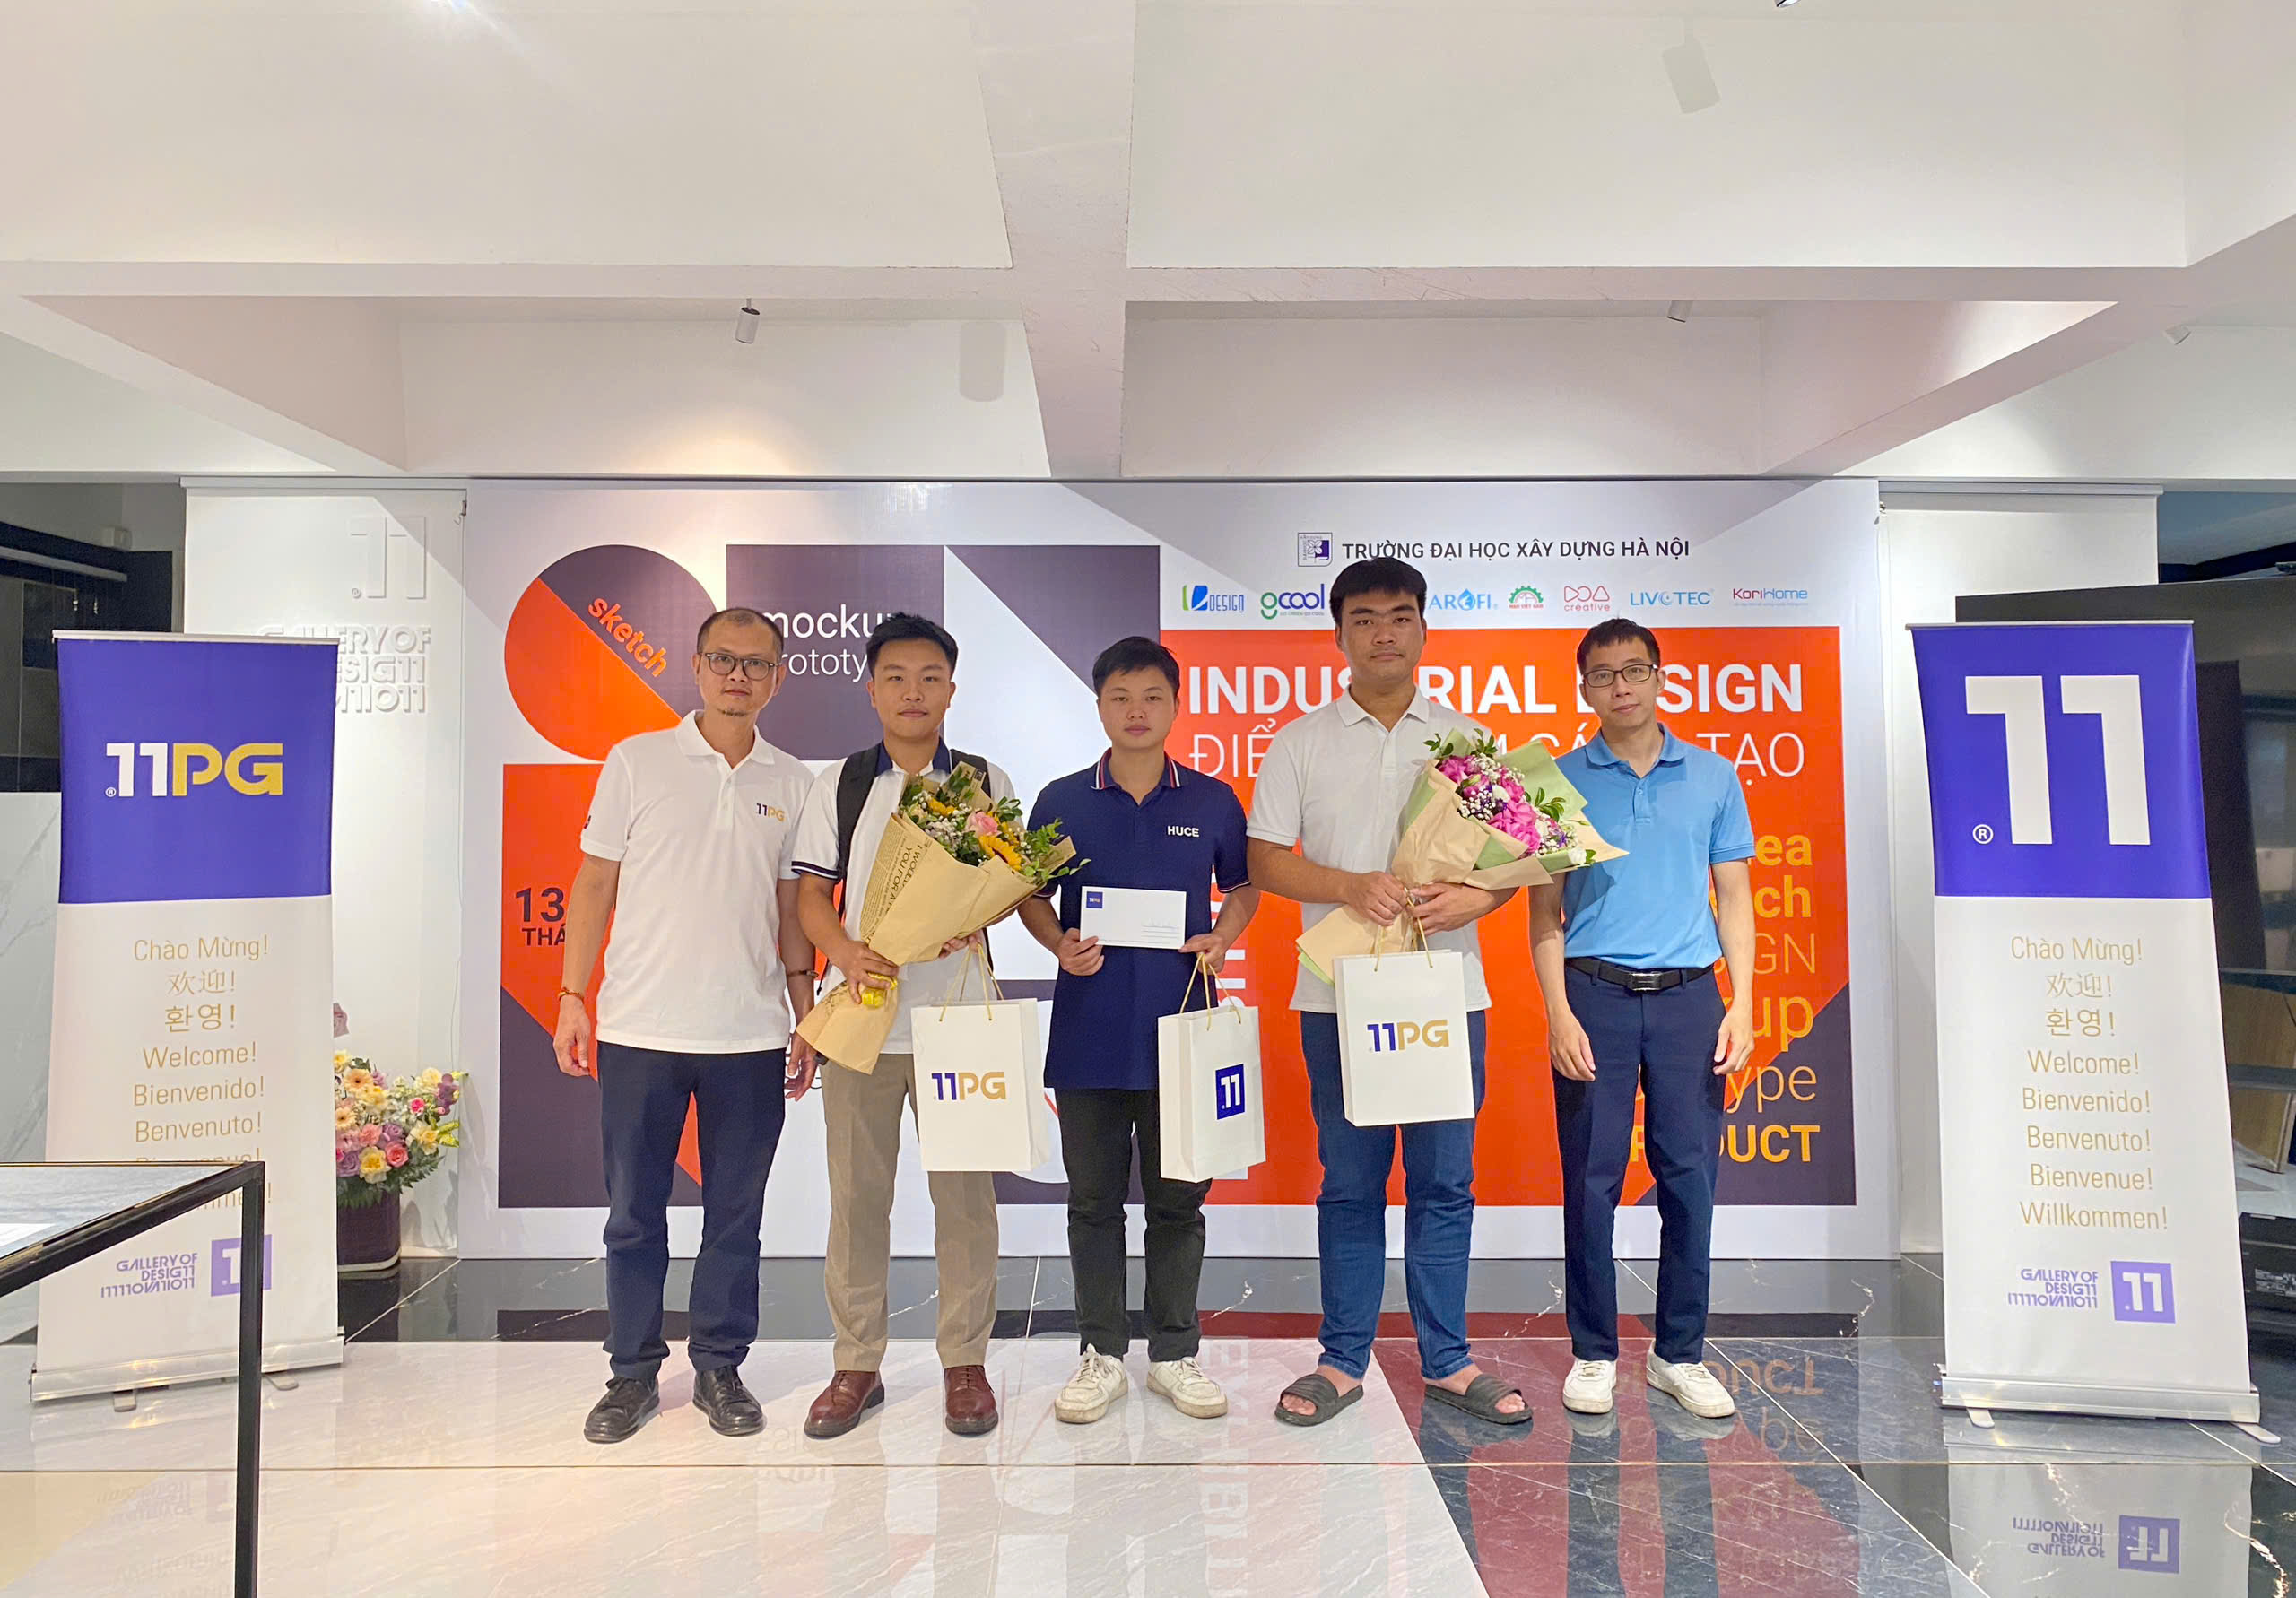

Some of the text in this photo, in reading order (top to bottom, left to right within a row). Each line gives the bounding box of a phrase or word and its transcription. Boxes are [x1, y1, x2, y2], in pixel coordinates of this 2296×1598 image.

[1343, 536, 1690, 562] TRƯỜNG ĐẠI HỌC XÂY DỰNG HÀ NỘI
[1260, 583, 1326, 620] gcool
[1732, 587, 1809, 601] KoriHome
[1563, 604, 1611, 612] creative
[587, 596, 669, 679] sketch
[105, 742, 283, 797] 11PG
[756, 803, 786, 822] 11PG
[1167, 825, 1200, 838] HUCE
[134, 934, 269, 961] Chào Mừng!
[2011, 936, 2143, 966] Chào Mừng!
[1366, 1019, 1449, 1052] 11PG
[142, 1040, 257, 1070] Welcome!
[2027, 1049, 2140, 1075] Welcome!
[134, 1075, 265, 1107] Bienvenido!
[931, 1071, 1006, 1101] 11PG
[2022, 1087, 2151, 1114] Bienvenido!
[135, 1111, 262, 1143] Benvenuto!
[2027, 1125, 2152, 1152] Benvenuto!
[2030, 1163, 2153, 1191] Bienvenue!
[2019, 1201, 2168, 1230] Willkommen!
[179, 1253, 198, 1265] OF
[2080, 1271, 2099, 1283] OF
